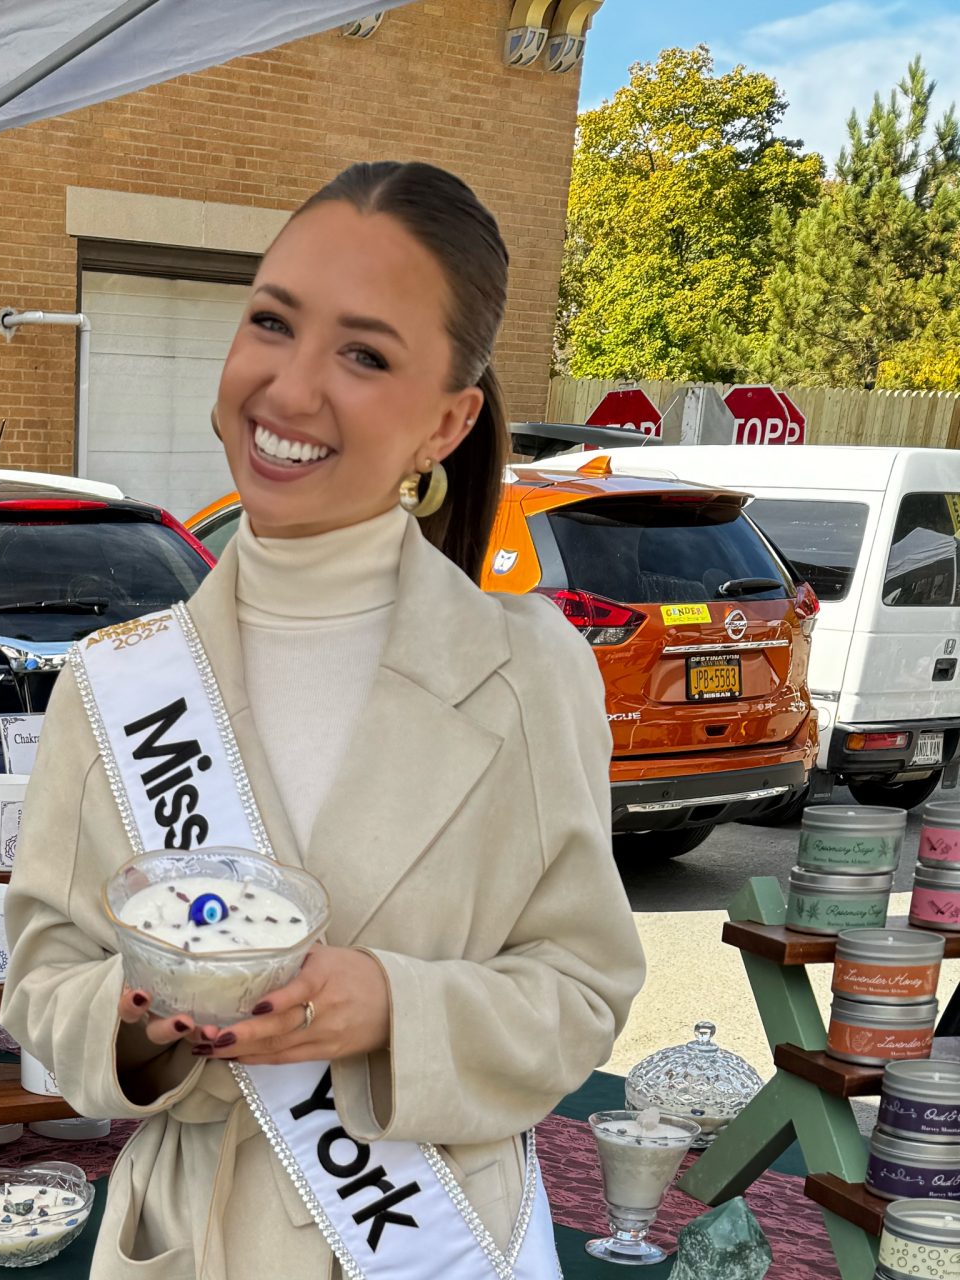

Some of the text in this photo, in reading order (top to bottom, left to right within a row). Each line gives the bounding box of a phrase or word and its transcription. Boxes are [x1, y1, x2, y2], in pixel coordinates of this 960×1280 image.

[112, 623, 170, 650] 2024
[691, 654, 740, 662] DESTINATION
[123, 696, 212, 850] Miss
[813, 839, 874, 855] Rosemary Sage
[826, 904, 867, 918] Rosemary
[843, 968, 923, 988] Lavender Honey
[877, 1036, 920, 1049] Lavender
[290, 1064, 421, 1253] York
